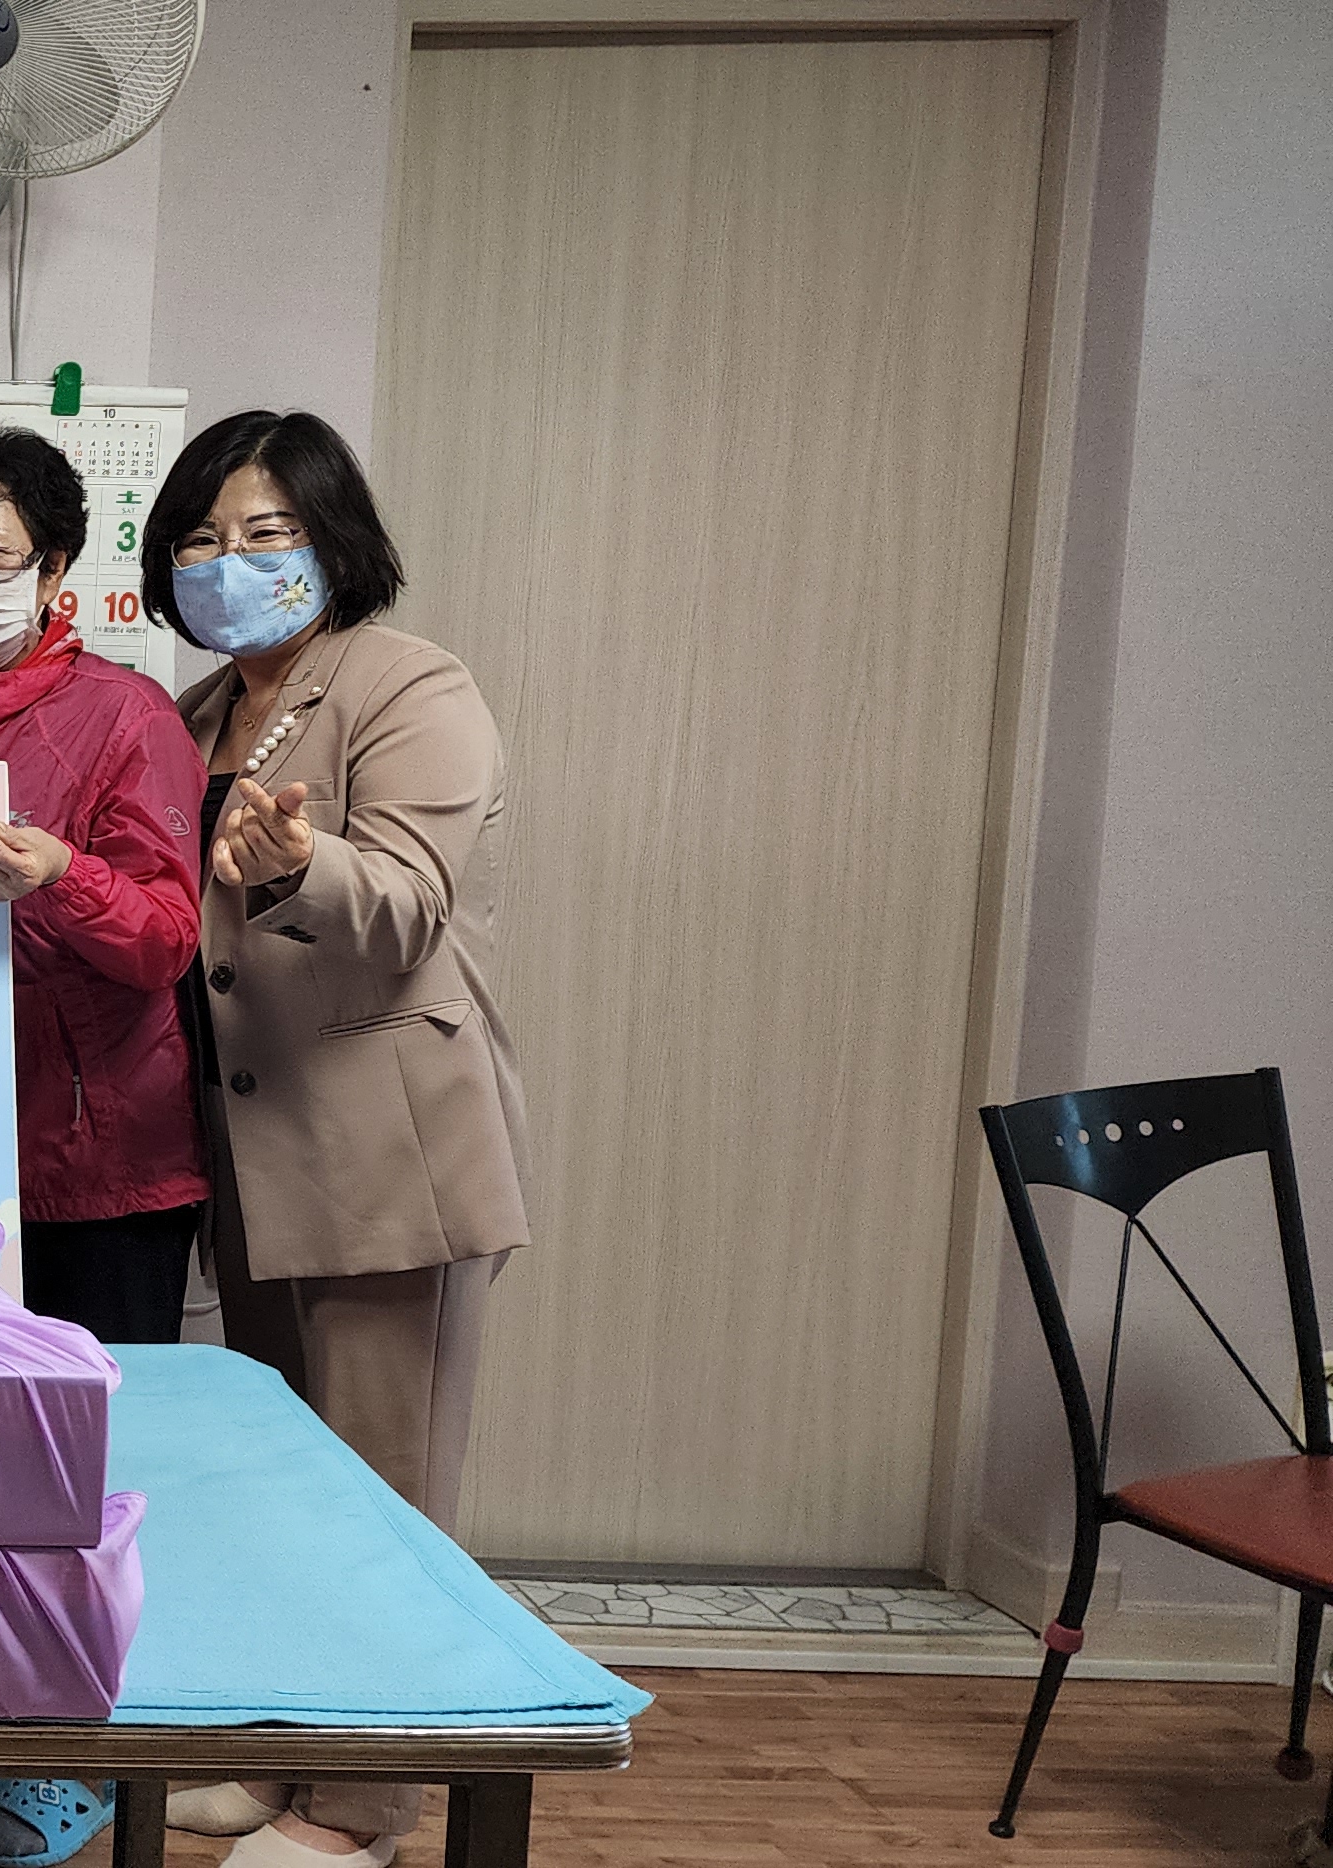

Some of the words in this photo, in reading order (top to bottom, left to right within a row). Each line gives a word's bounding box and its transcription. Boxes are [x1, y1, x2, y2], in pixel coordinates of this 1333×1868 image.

[103, 409, 116, 418] 10
[116, 490, 142, 504] 土
[116, 520, 137, 553] 3
[58, 590, 79, 622] 9
[104, 591, 139, 624] 10
